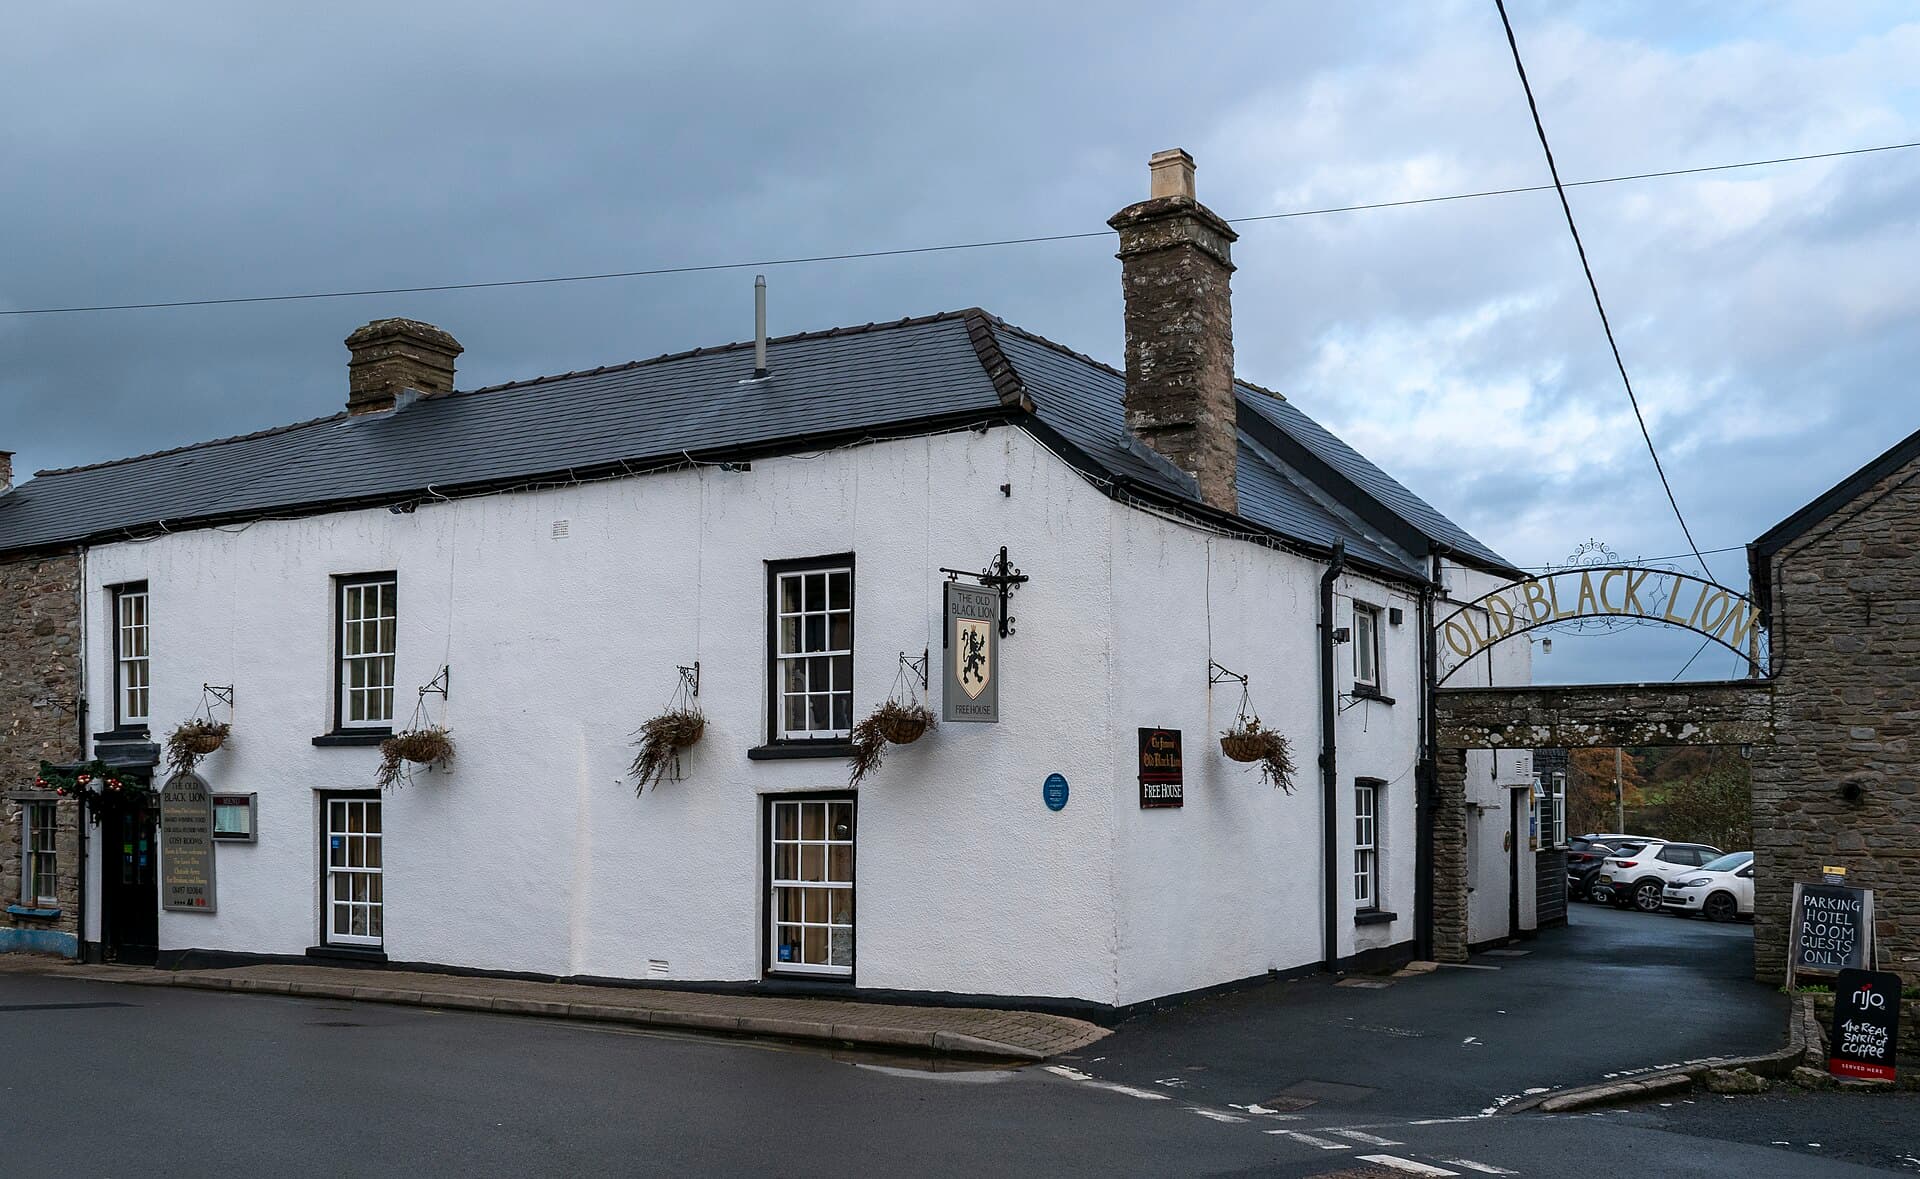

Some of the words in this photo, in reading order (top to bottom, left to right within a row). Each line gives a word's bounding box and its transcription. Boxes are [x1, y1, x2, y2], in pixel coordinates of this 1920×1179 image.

[957, 592, 973, 604] THE
[975, 595, 990, 606] OLD
[952, 602, 976, 617] BLACK
[977, 606, 995, 619] LION
[1445, 595, 1515, 657] OLD
[1523, 569, 1649, 624] BLACK
[1664, 576, 1762, 648] LION
[171, 782, 183, 790] THE
[184, 782, 199, 790] OLD
[164, 792, 187, 802] BLACK
[189, 792, 206, 802] LION
[1803, 895, 1861, 913] PARKING
[1806, 908, 1853, 926] HOTEL
[1802, 921, 1855, 941] ROOM
[1800, 935, 1853, 953] GUESTS
[1804, 949, 1850, 966] ONLY
[1841, 1019, 1860, 1033] The
[1875, 1036, 1888, 1047] of
[1841, 1063, 1865, 1072] SERVED
